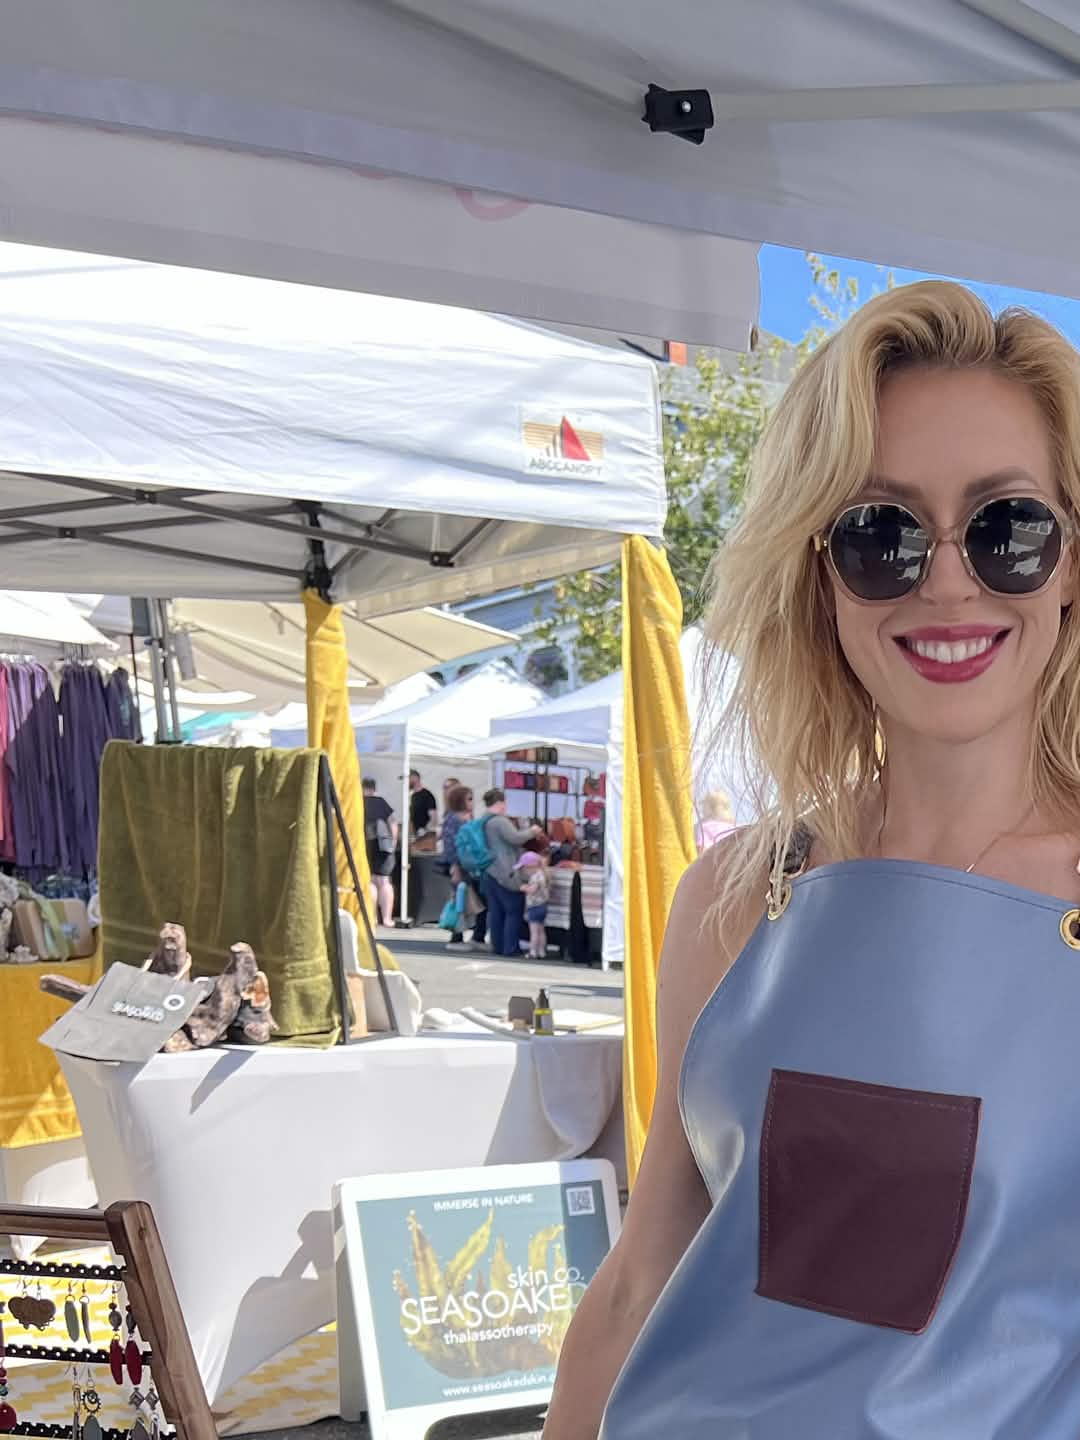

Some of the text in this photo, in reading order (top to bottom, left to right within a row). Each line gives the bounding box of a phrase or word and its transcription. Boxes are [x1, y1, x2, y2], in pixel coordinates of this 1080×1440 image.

[434, 1192, 534, 1212] IMMERSE IN NATURE
[507, 1266, 585, 1289] skin co.
[401, 1282, 588, 1335] SEASOAKED
[443, 1320, 554, 1345] thalassotherapy
